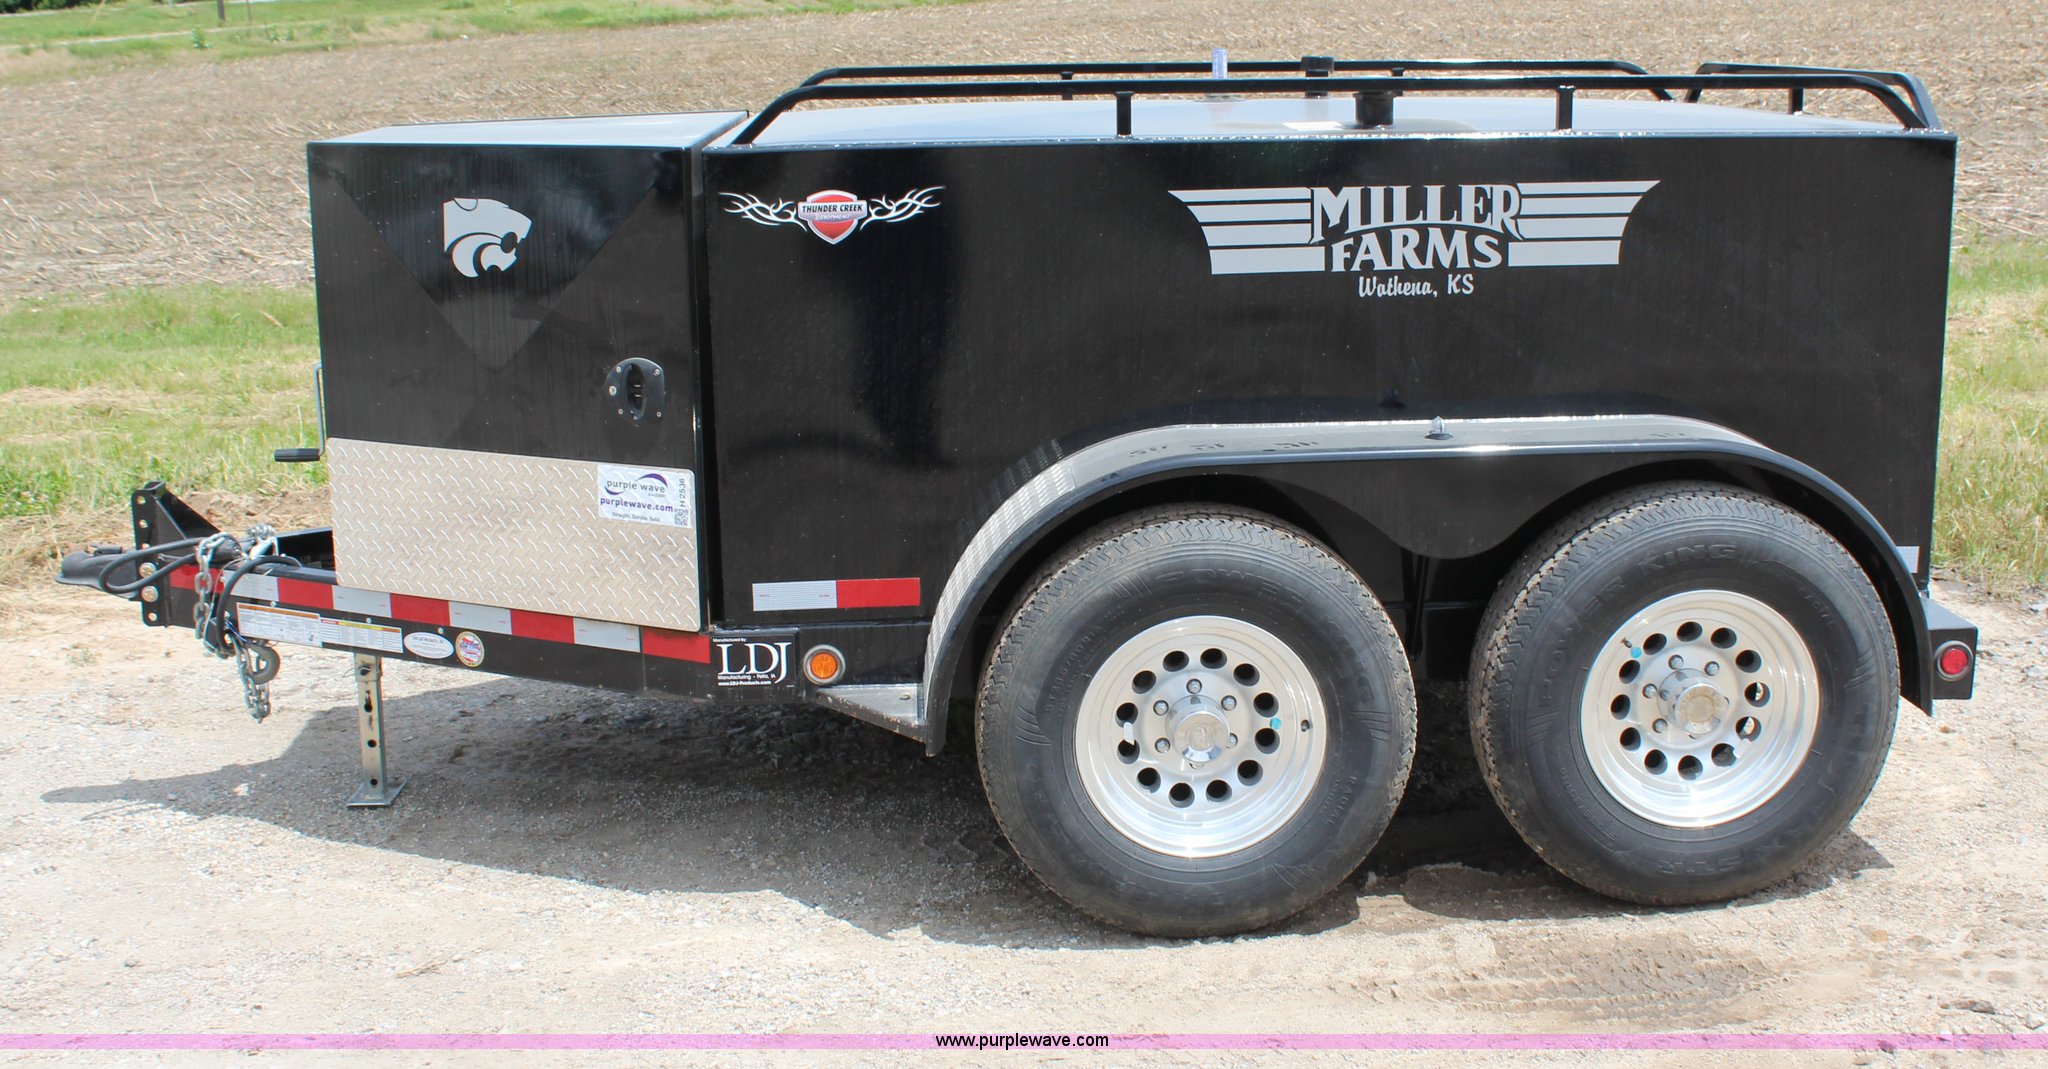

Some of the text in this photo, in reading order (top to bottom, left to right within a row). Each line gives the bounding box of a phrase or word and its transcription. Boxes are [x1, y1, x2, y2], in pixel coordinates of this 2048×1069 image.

[802, 203, 863, 213] THUNDER CREEK
[1308, 184, 1523, 244] MILLER
[1331, 226, 1502, 272] FARMS
[1358, 273, 1475, 298] Wathena, KS
[606, 480, 666, 493] purple wave
[600, 498, 673, 512] purplewave.com
[1637, 543, 1737, 573] KING
[716, 642, 792, 684] LDJ
